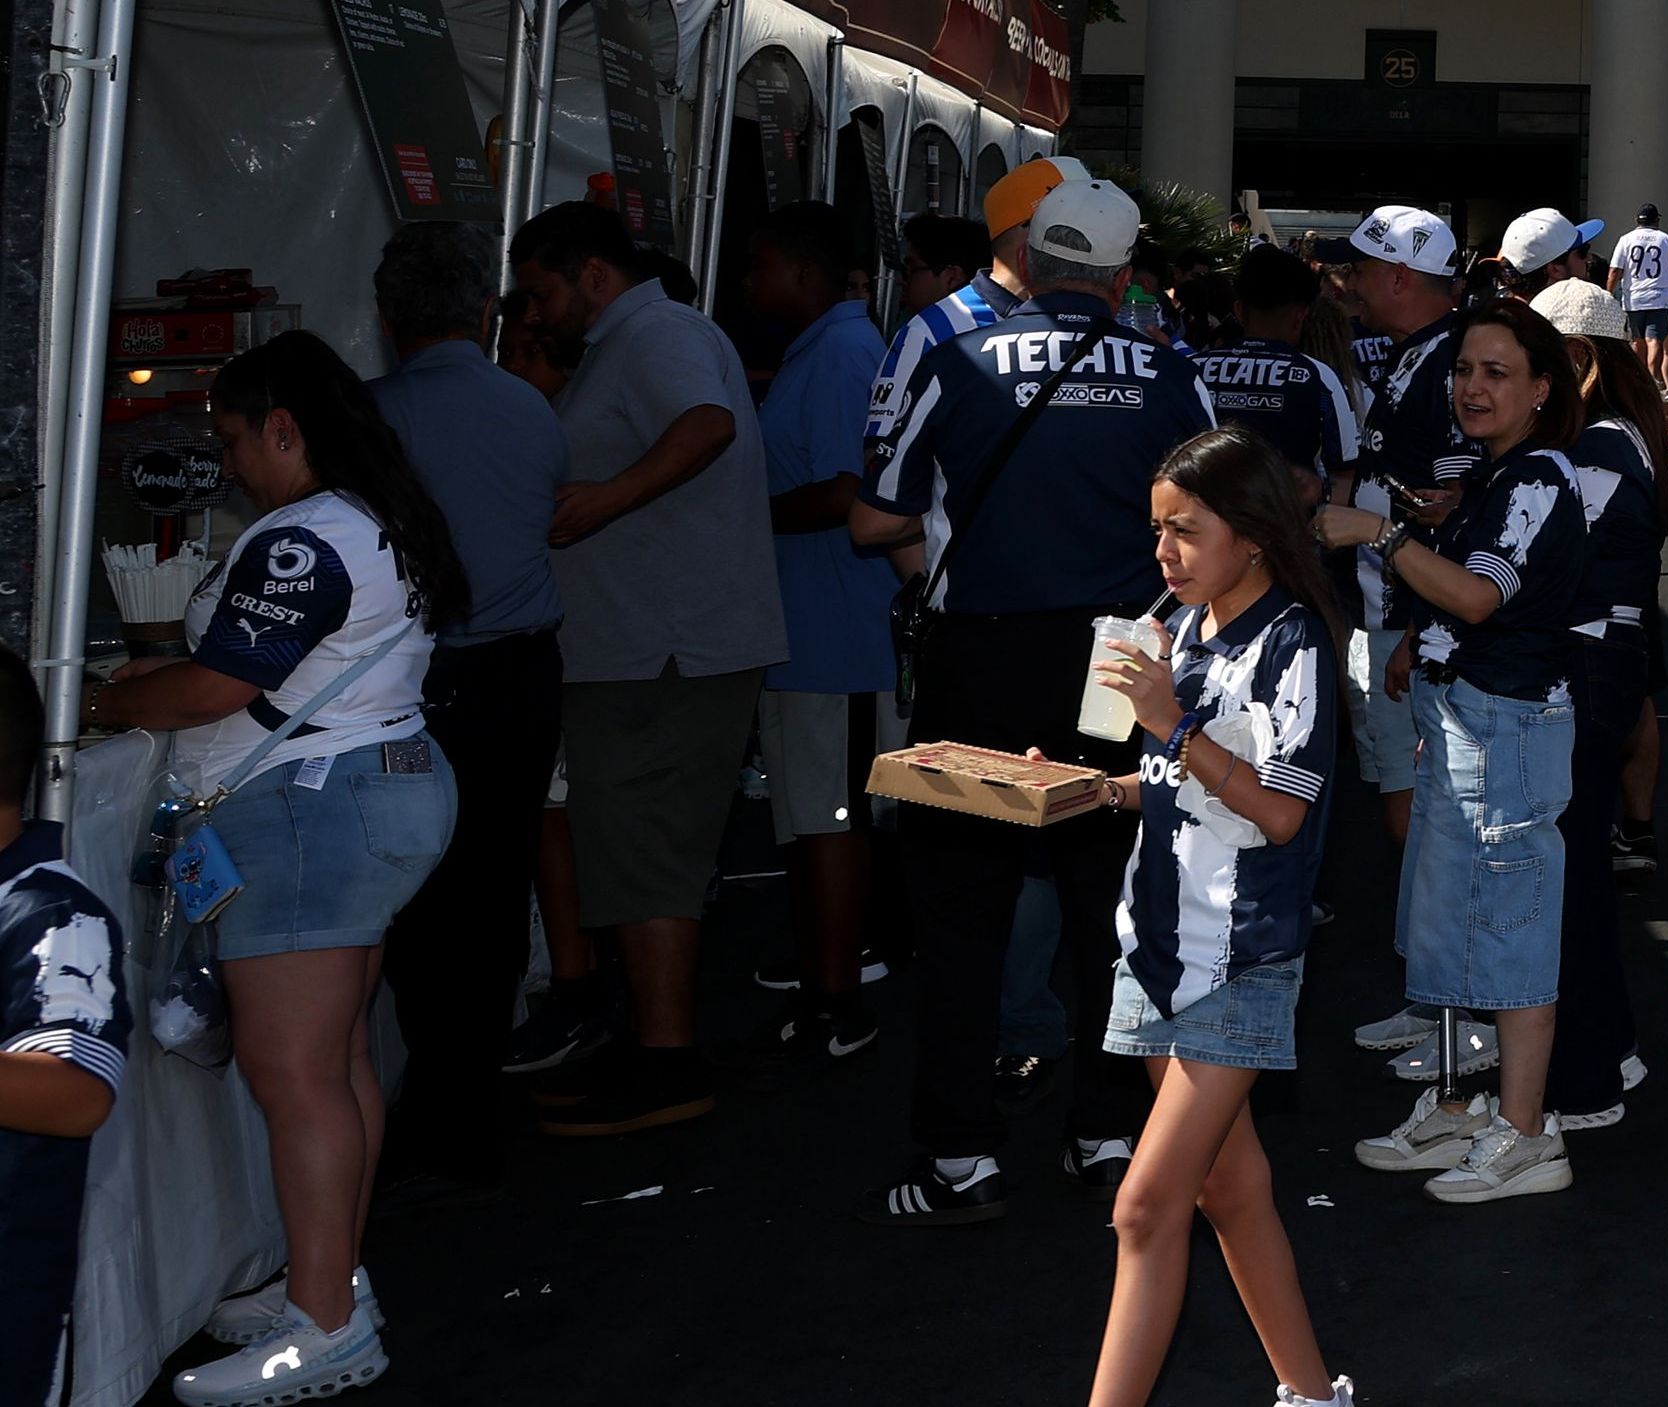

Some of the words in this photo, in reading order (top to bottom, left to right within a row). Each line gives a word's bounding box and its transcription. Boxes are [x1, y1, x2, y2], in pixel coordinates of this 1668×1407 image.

[1384, 57, 1416, 79] 25
[1630, 245, 1661, 279] 93
[126, 321, 160, 338] Hola
[981, 331, 1159, 379] TECATE
[132, 464, 188, 488] Lemonade
[263, 576, 315, 595] Berel
[231, 592, 305, 627] CREST
